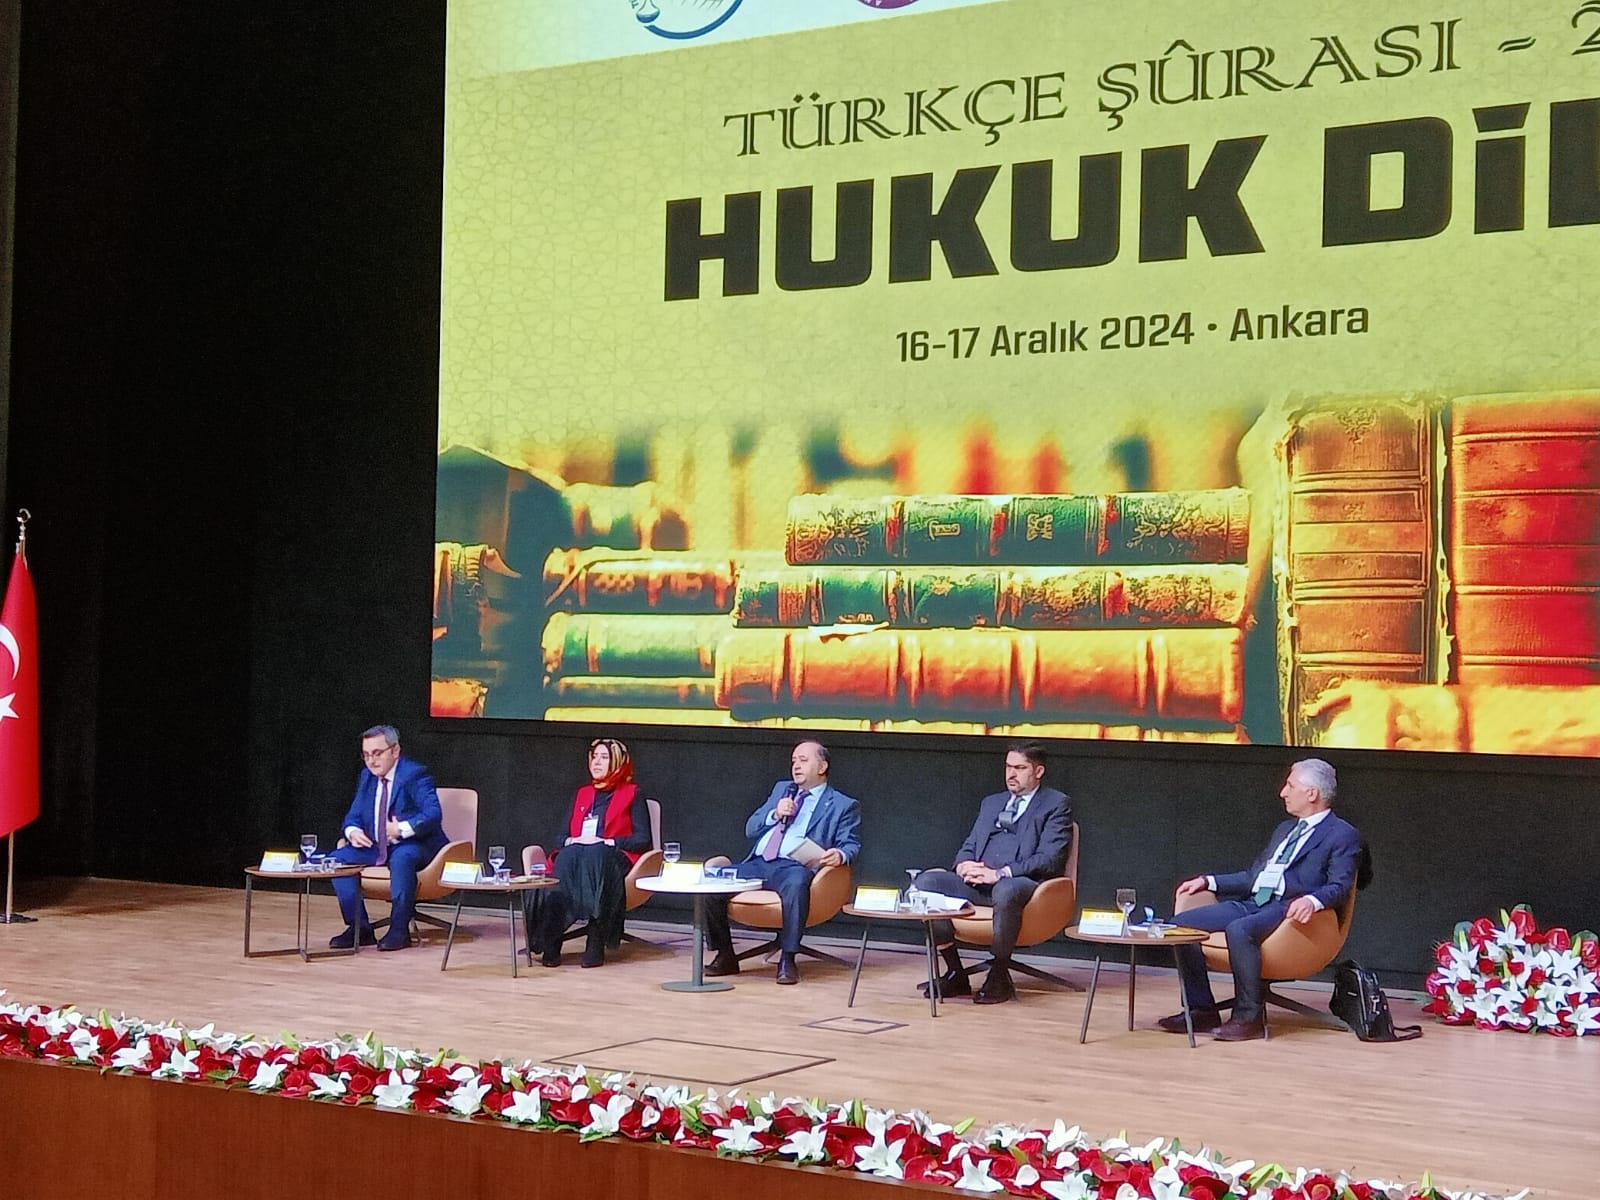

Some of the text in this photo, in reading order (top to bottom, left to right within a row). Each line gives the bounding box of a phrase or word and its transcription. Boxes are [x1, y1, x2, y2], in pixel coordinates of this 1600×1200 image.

[724, 72, 1067, 156] TÜRKÇE
[1097, 18, 1462, 132] ŞÛRASI
[664, 134, 1268, 301] HUKUK
[897, 327, 981, 362] 16-17
[991, 318, 1089, 357] Aralık
[1100, 313, 1195, 350] 2024
[1229, 304, 1369, 342] Ankara
